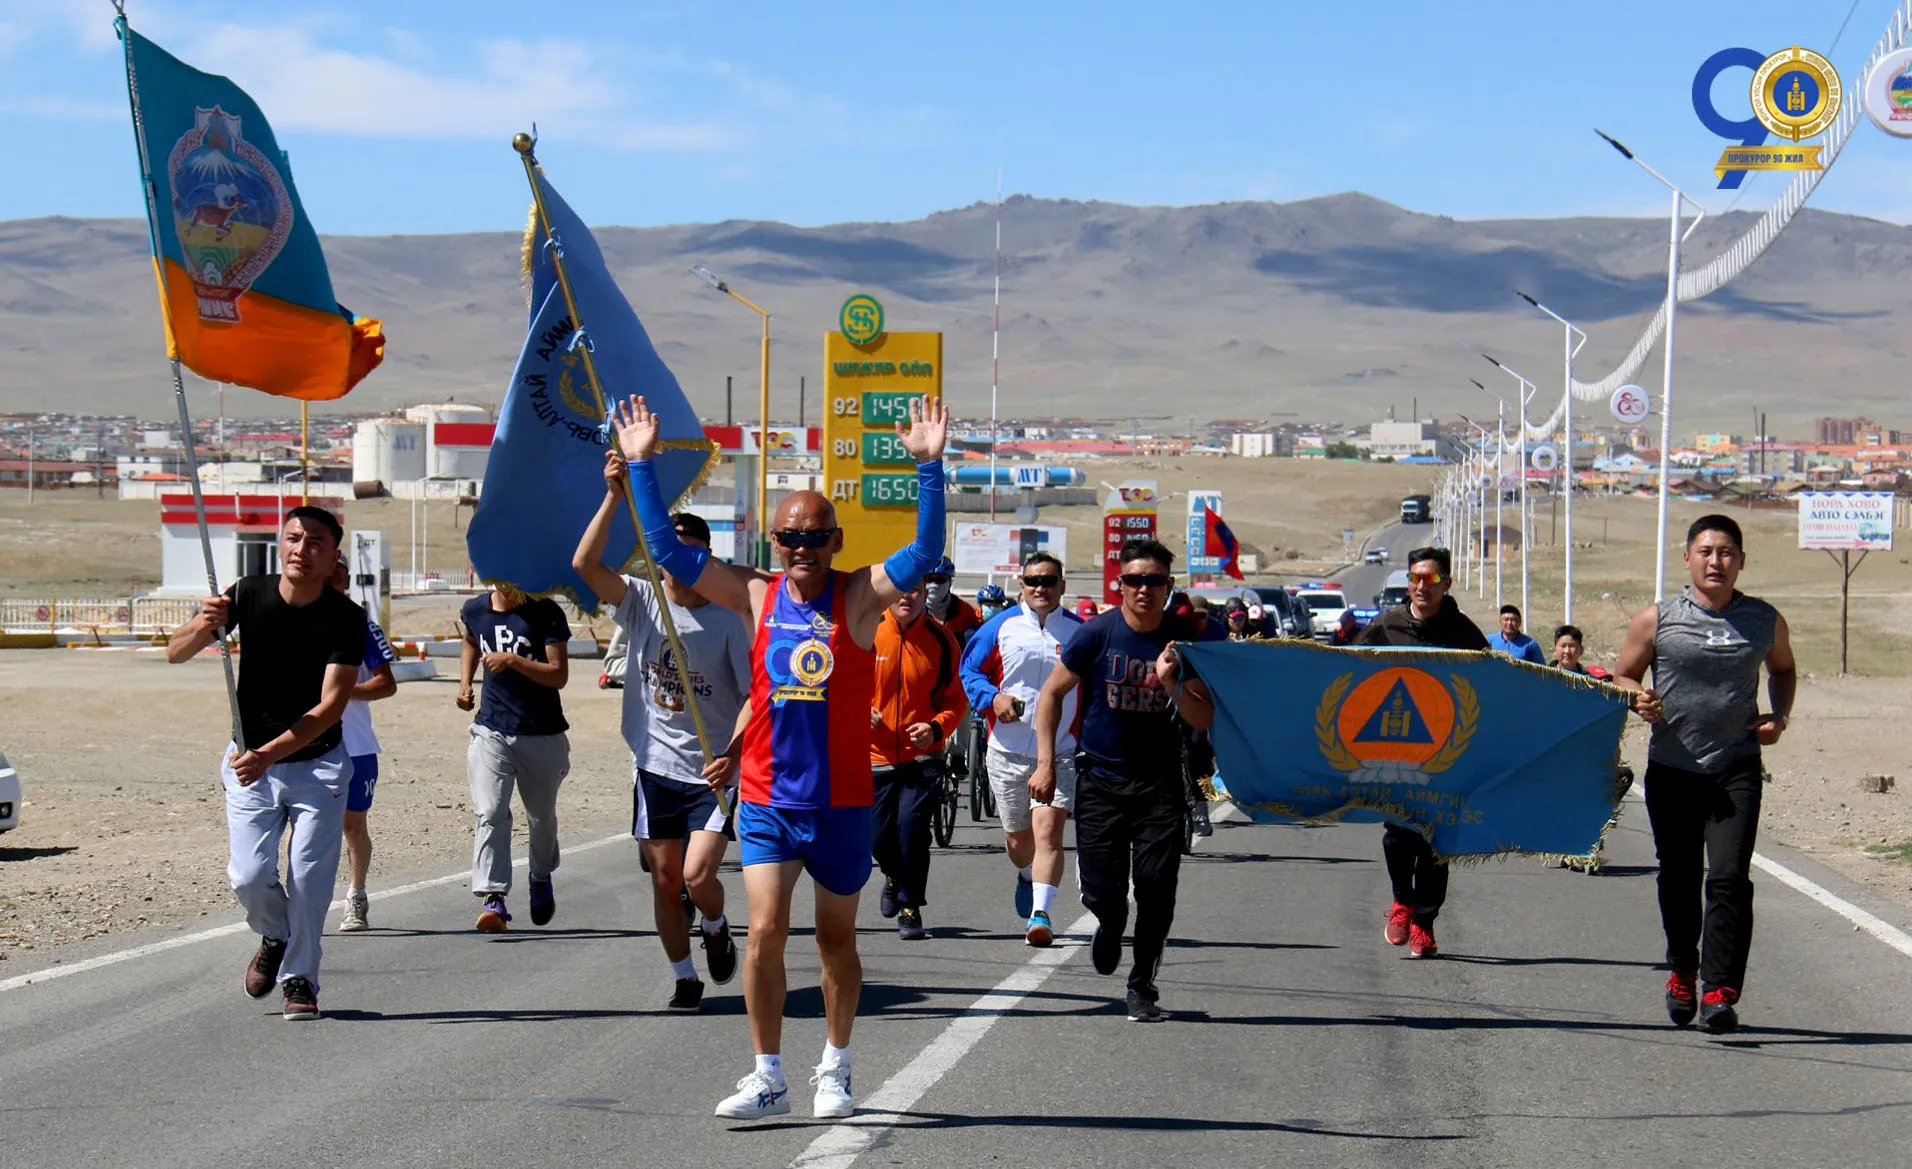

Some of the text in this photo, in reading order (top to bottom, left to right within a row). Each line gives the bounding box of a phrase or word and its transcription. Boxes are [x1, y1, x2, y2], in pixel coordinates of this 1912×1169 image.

[524, 315, 604, 446] ОВЬ-АЛТАЙ АЙМ
[833, 397, 858, 416] 92
[833, 437, 916, 459] 80 135
[832, 479, 919, 501] ДТ 1650
[1809, 511, 1840, 520] АВТО
